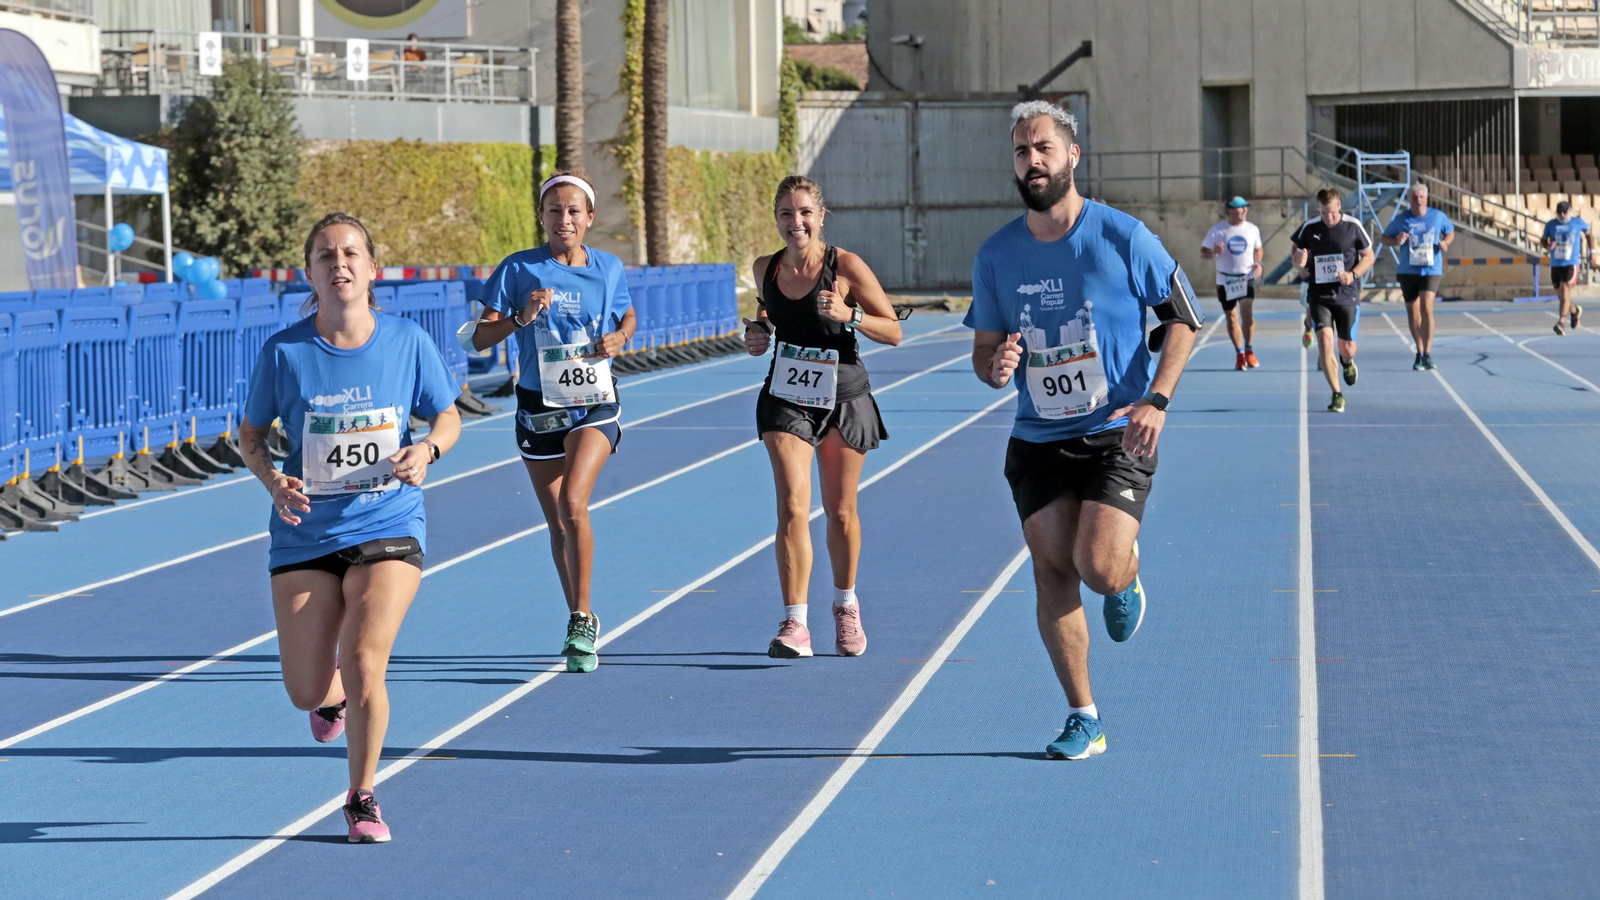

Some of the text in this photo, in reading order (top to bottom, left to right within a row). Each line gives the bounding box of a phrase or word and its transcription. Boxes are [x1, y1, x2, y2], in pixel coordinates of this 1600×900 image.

[1322, 264, 1338, 274] 152
[1040, 278, 1063, 293] XLI
[559, 291, 581, 303] XLI
[1040, 292, 1064, 300] Carrera
[1040, 299, 1065, 307] Popular
[558, 366, 598, 387] 488
[786, 367, 823, 388] 247
[1042, 370, 1087, 397] 901
[342, 385, 372, 403] XLI
[342, 401, 374, 411] Carrera
[326, 442, 380, 468] 450
